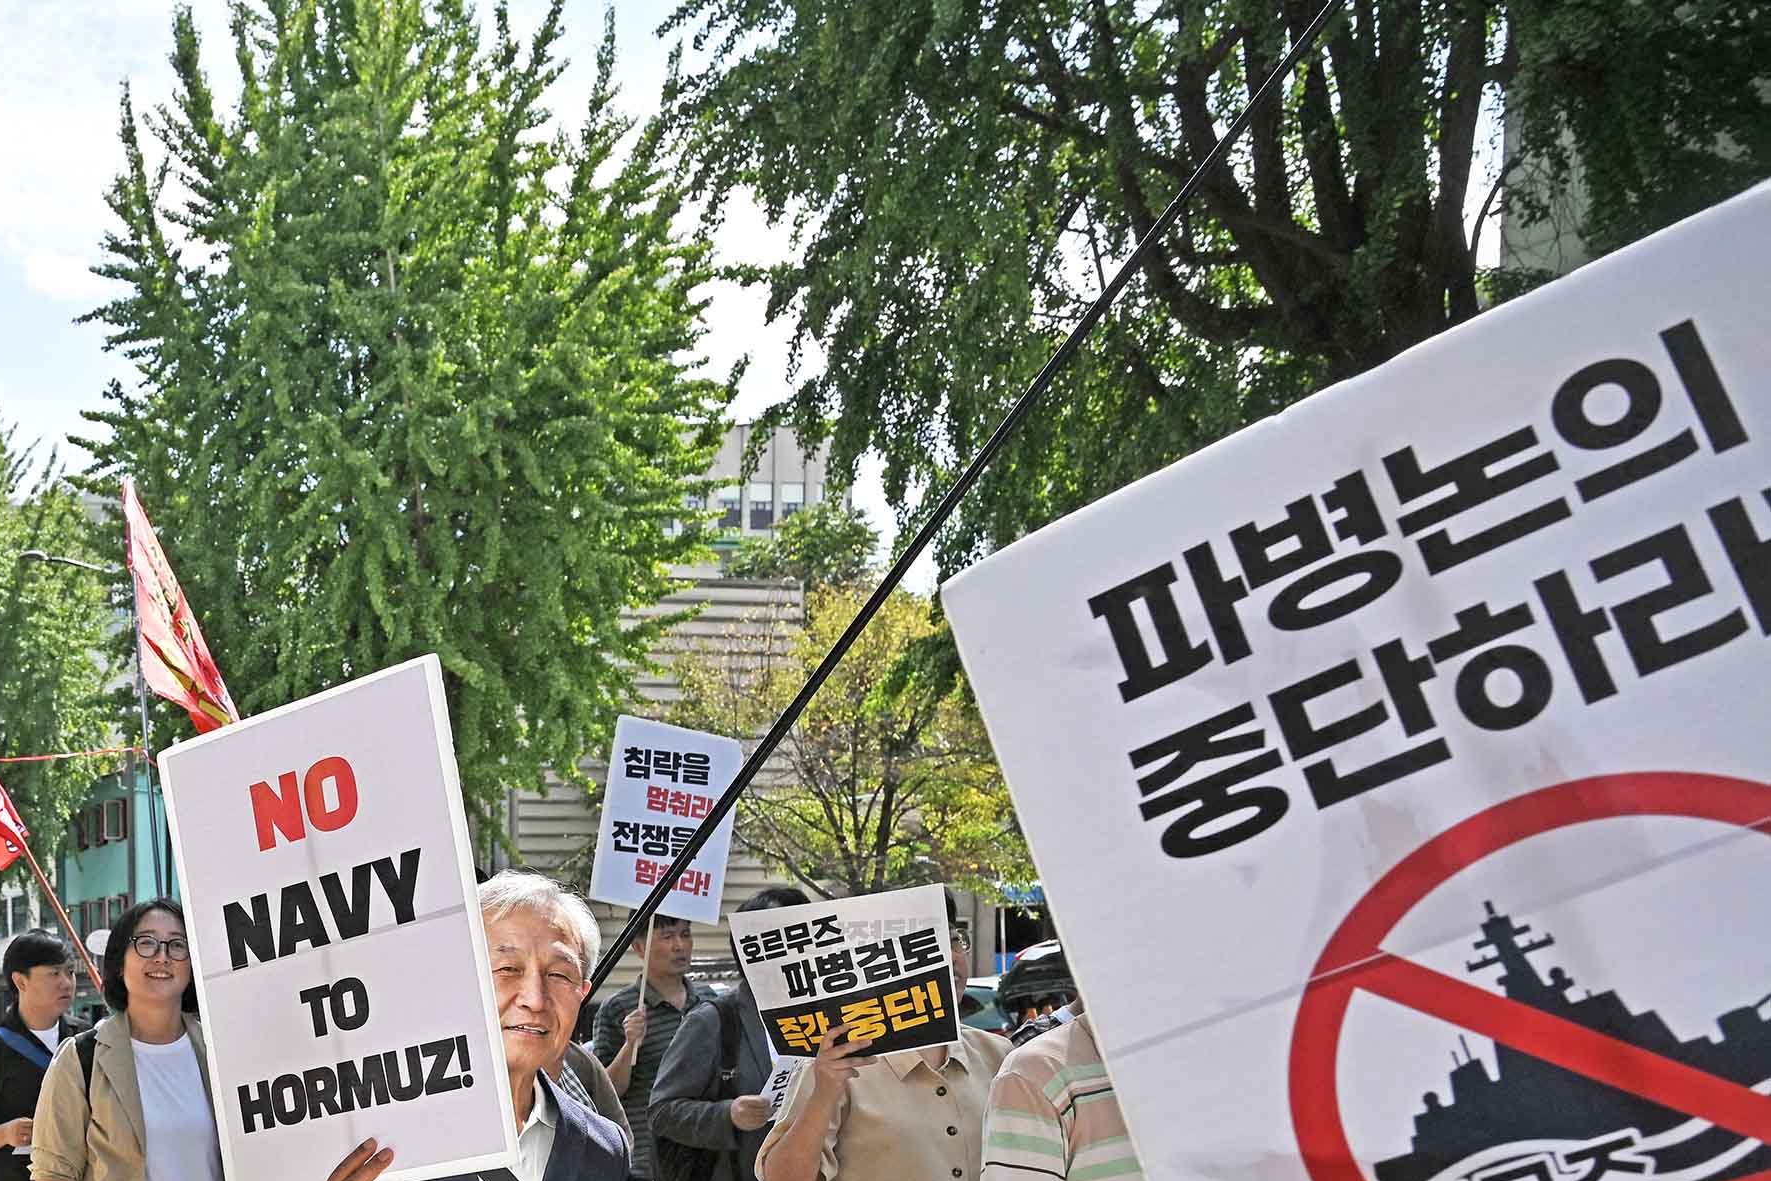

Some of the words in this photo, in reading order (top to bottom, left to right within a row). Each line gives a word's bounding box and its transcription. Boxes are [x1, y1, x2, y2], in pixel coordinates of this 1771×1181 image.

[1088, 319, 1749, 702] 파병논의
[1128, 488, 1771, 860] 중단하라
[624, 747, 710, 786] 침략을
[249, 756, 358, 852] NO
[612, 821, 696, 860] 전쟁을
[223, 848, 421, 971] NAVY
[740, 914, 845, 965] 호르무즈
[781, 927, 945, 999] 파병검토
[300, 976, 369, 1037] TO
[776, 1011, 831, 1053] 즉각
[840, 980, 946, 1043] 중단!
[237, 1035, 473, 1133] HORMUZ!
